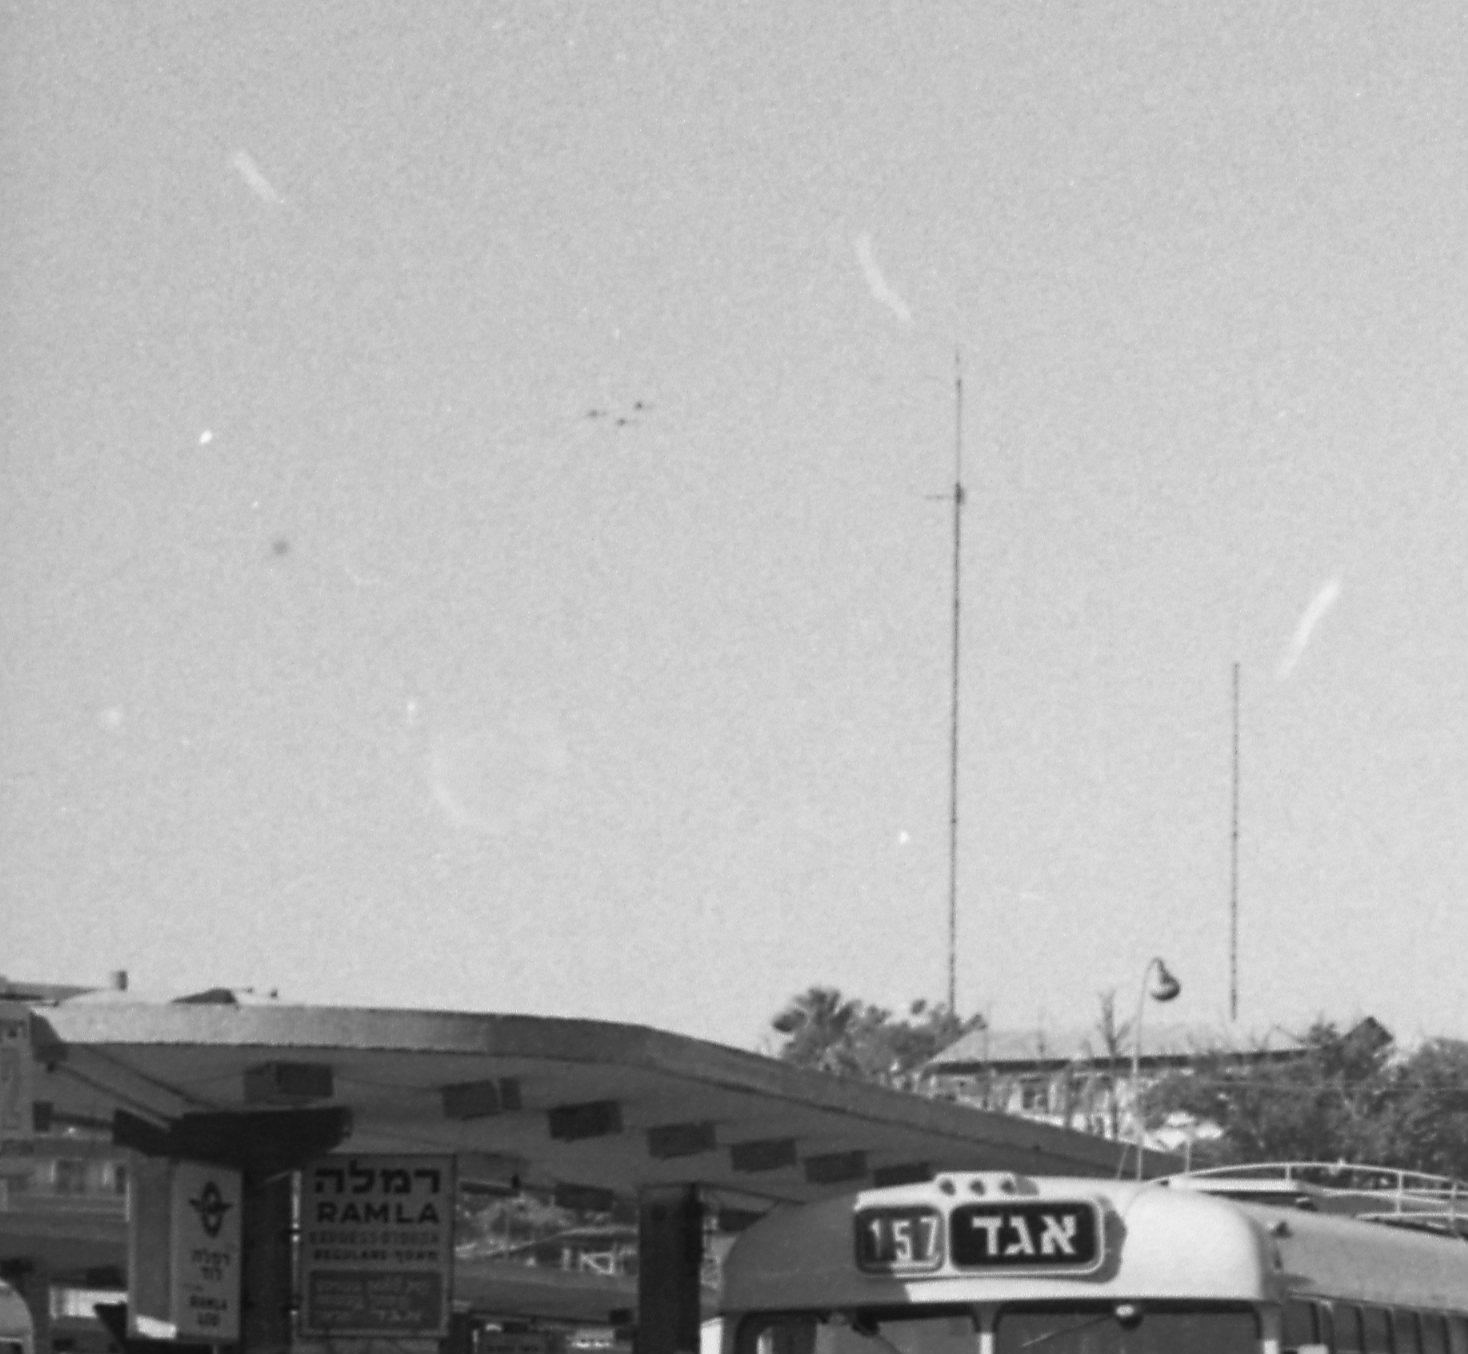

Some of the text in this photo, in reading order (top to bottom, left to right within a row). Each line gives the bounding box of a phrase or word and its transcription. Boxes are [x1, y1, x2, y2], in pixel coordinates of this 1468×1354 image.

[314, 1160, 441, 1194] רמלה
[317, 1202, 439, 1223] RAMLA
[870, 1216, 940, 1262] 157
[973, 1215, 1077, 1257] אגד
